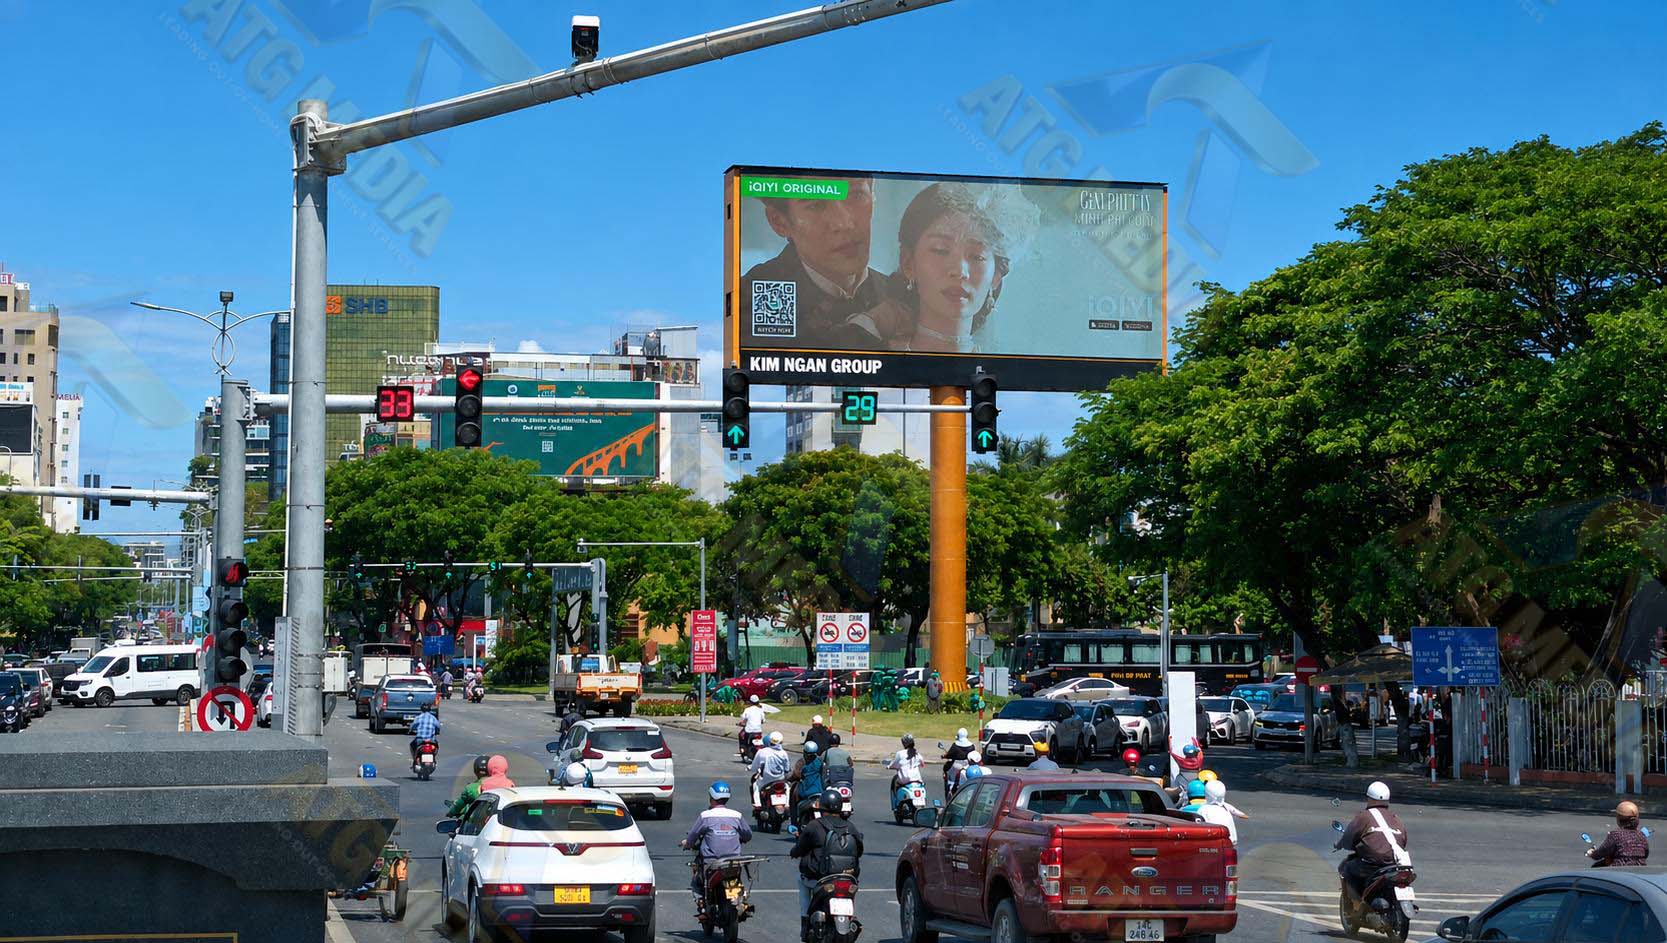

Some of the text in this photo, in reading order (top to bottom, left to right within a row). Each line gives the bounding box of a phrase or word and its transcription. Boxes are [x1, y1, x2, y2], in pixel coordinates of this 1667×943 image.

[783, 183, 841, 195] ORIGINAL
[345, 296, 389, 315] SHB
[750, 356, 882, 374] KIM NGAN GROUP
[379, 390, 412, 418] 33
[845, 395, 875, 421] 29
[1069, 885, 1219, 896] RANGER
